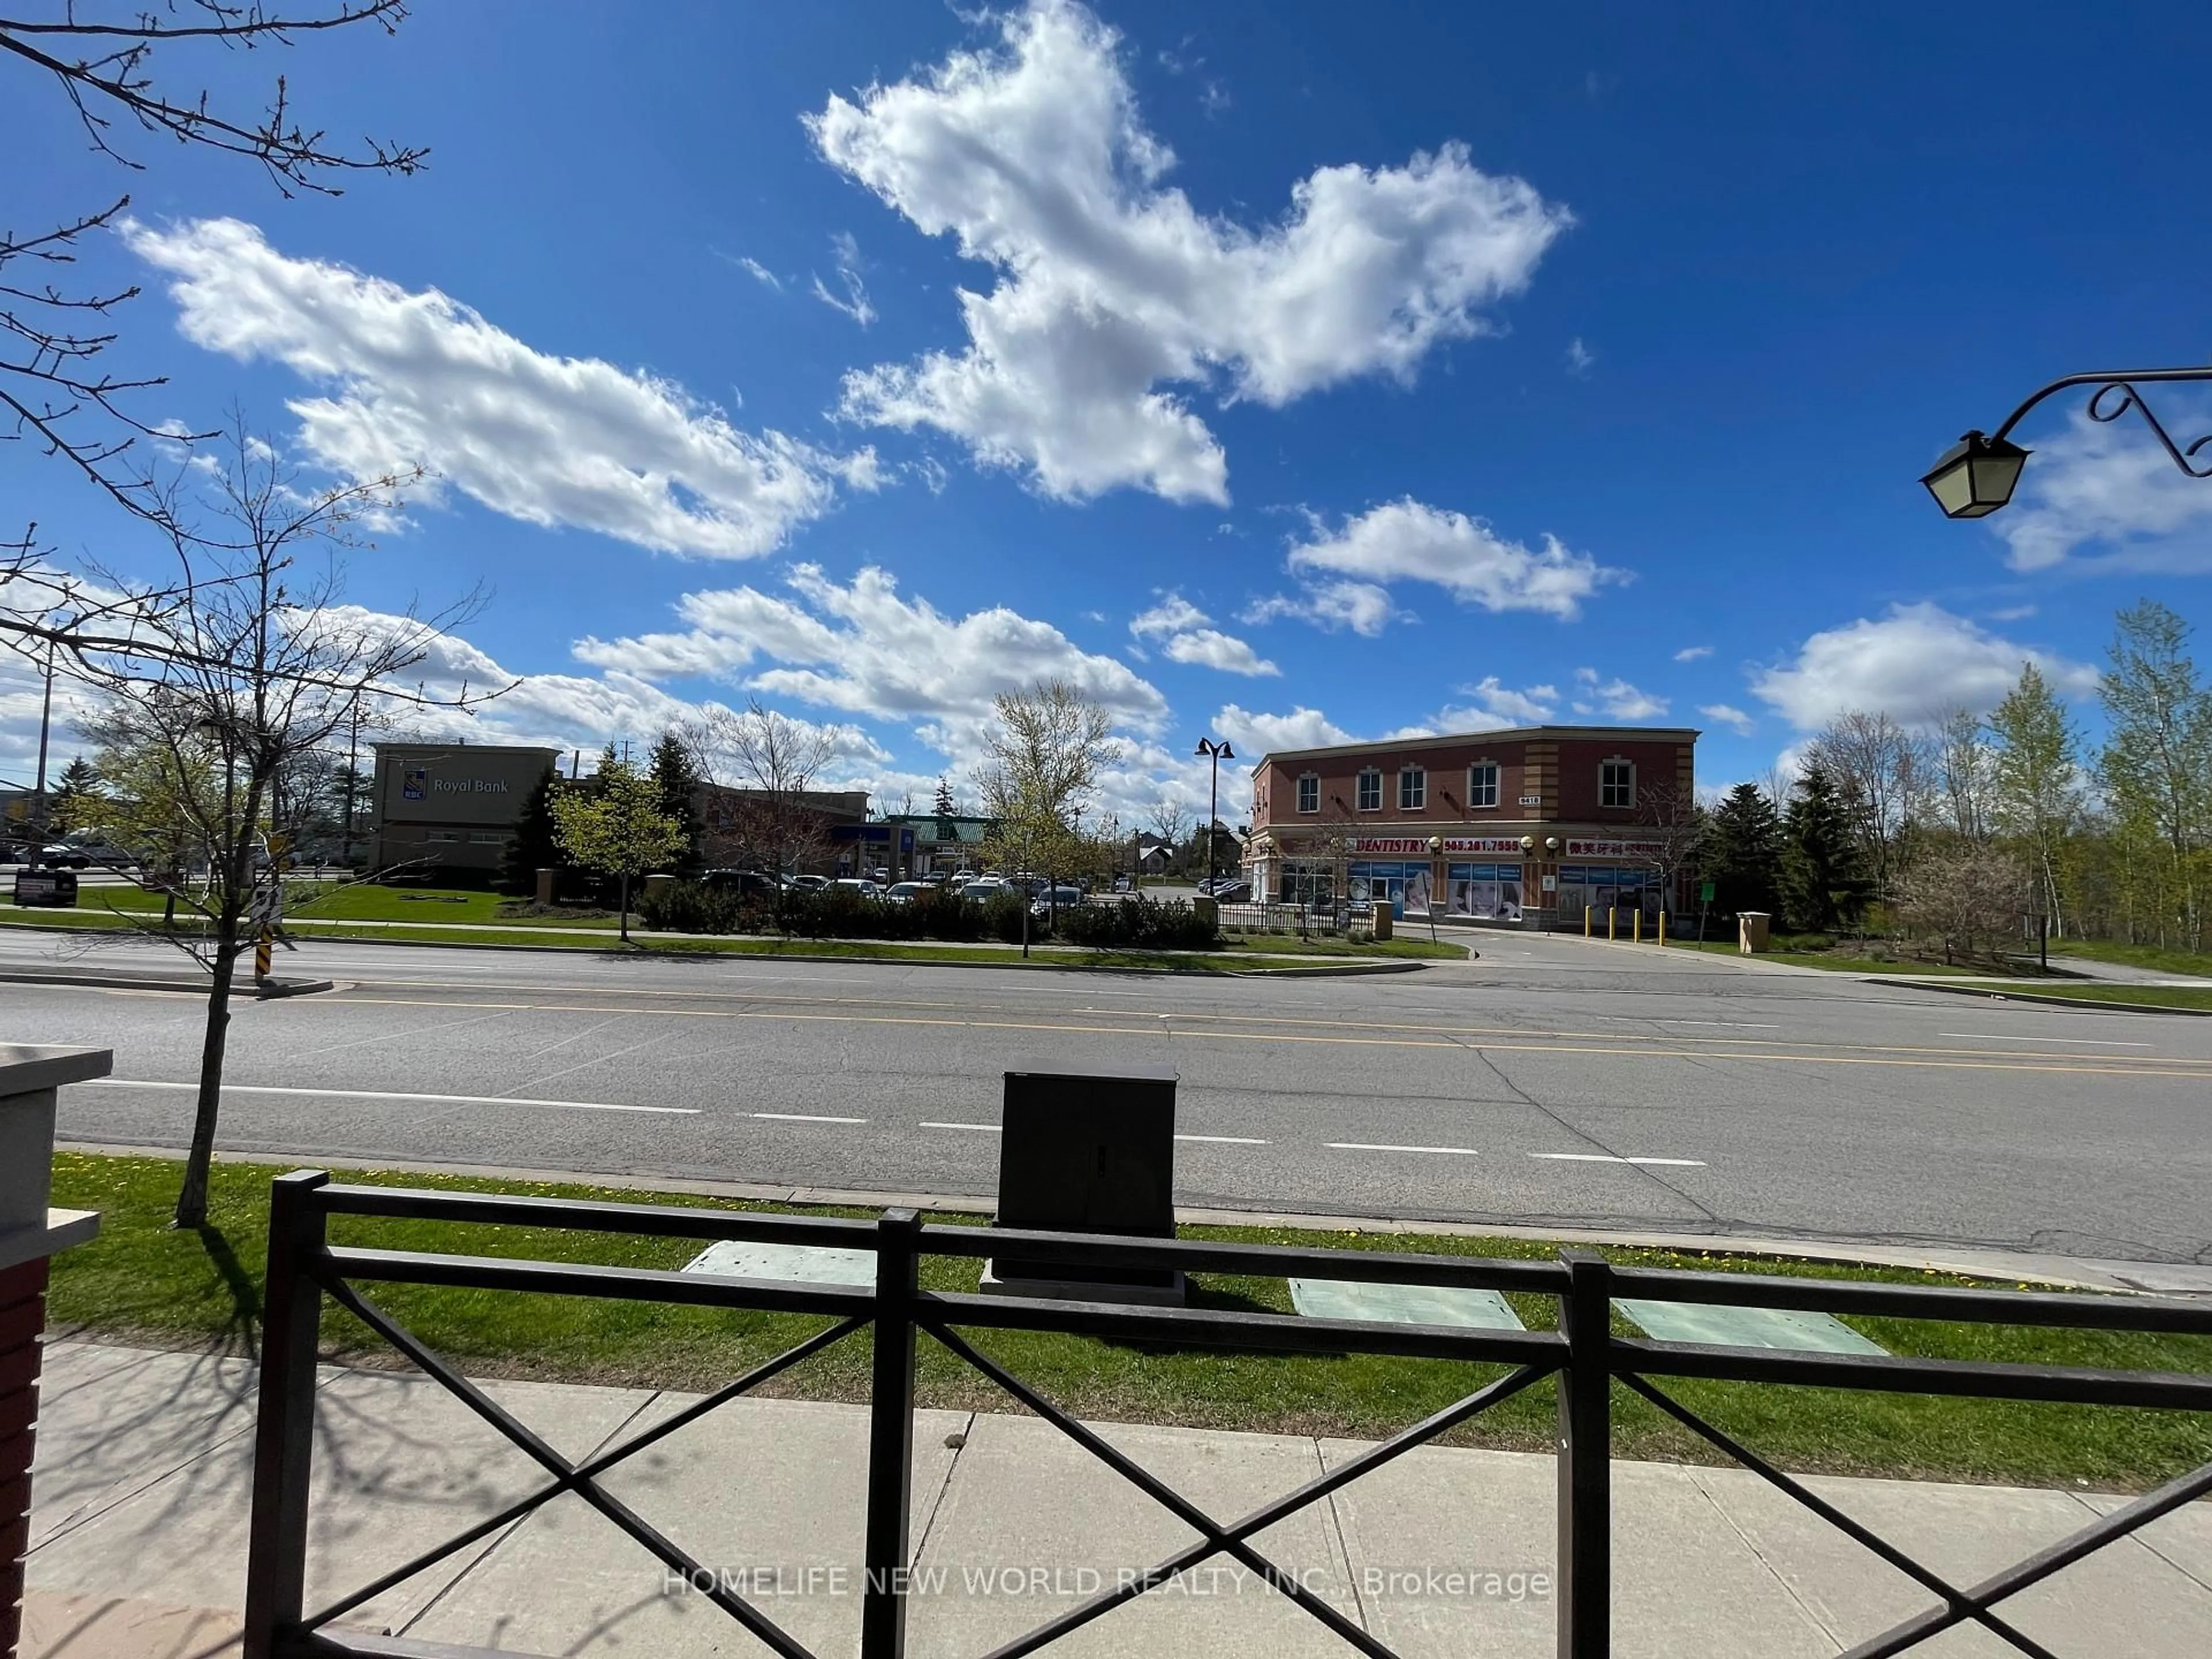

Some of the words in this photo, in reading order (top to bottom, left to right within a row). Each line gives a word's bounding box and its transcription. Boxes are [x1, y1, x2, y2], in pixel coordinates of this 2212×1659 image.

[434, 779, 471, 794] Royal
[475, 779, 508, 793] Bank
[1356, 839, 1428, 852] DENTISTRY
